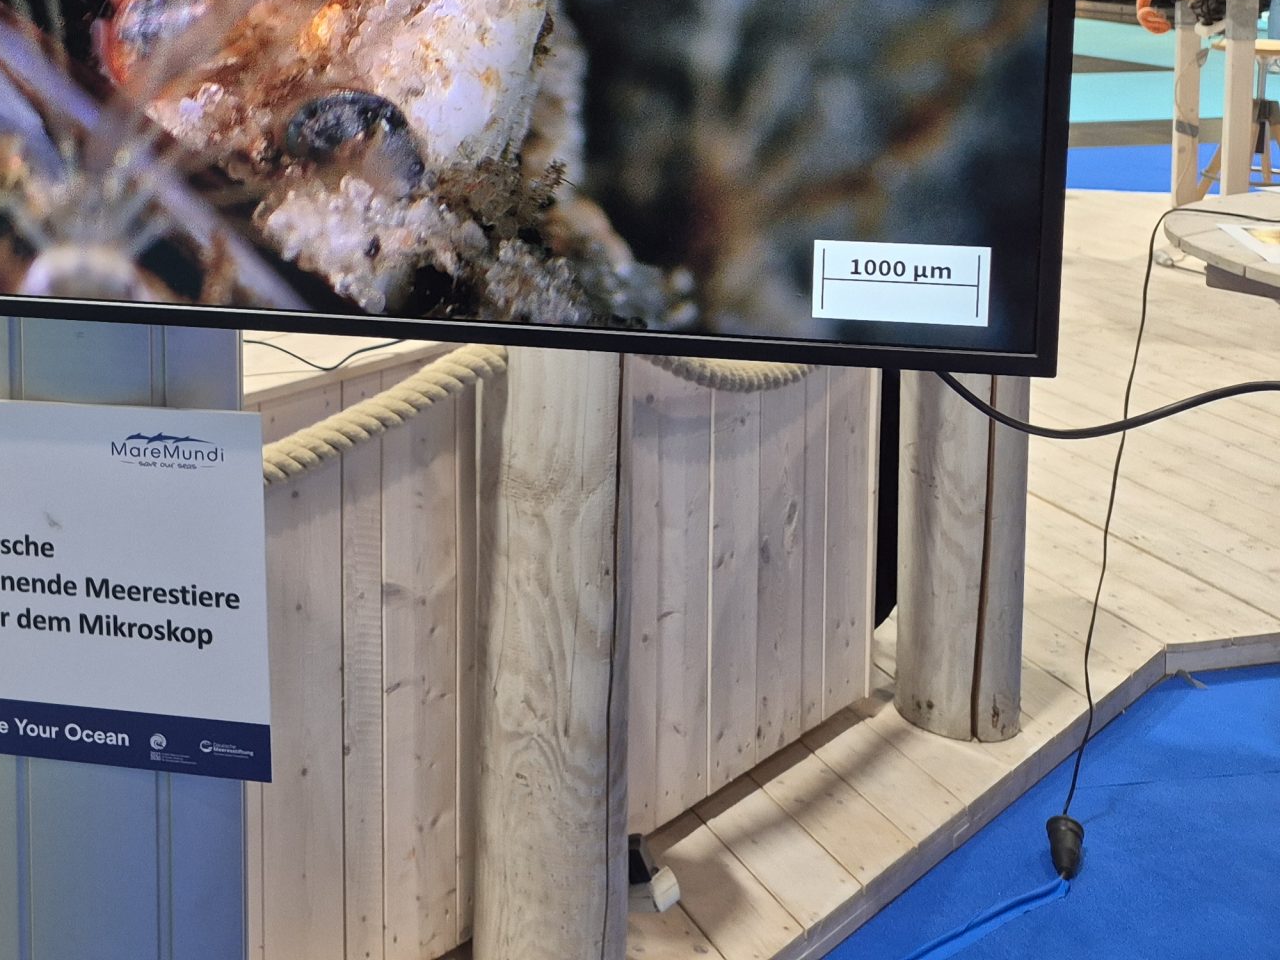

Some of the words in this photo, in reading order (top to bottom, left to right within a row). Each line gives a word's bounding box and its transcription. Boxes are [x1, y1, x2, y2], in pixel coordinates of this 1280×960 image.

[850, 258, 906, 278] 1000
[111, 441, 224, 462] MareMundi
[85, 576, 241, 610] Meerestiere
[16, 607, 71, 633] dem
[79, 613, 213, 650] Mikroskop
[14, 717, 59, 739] Your
[64, 723, 131, 747] Ocean
